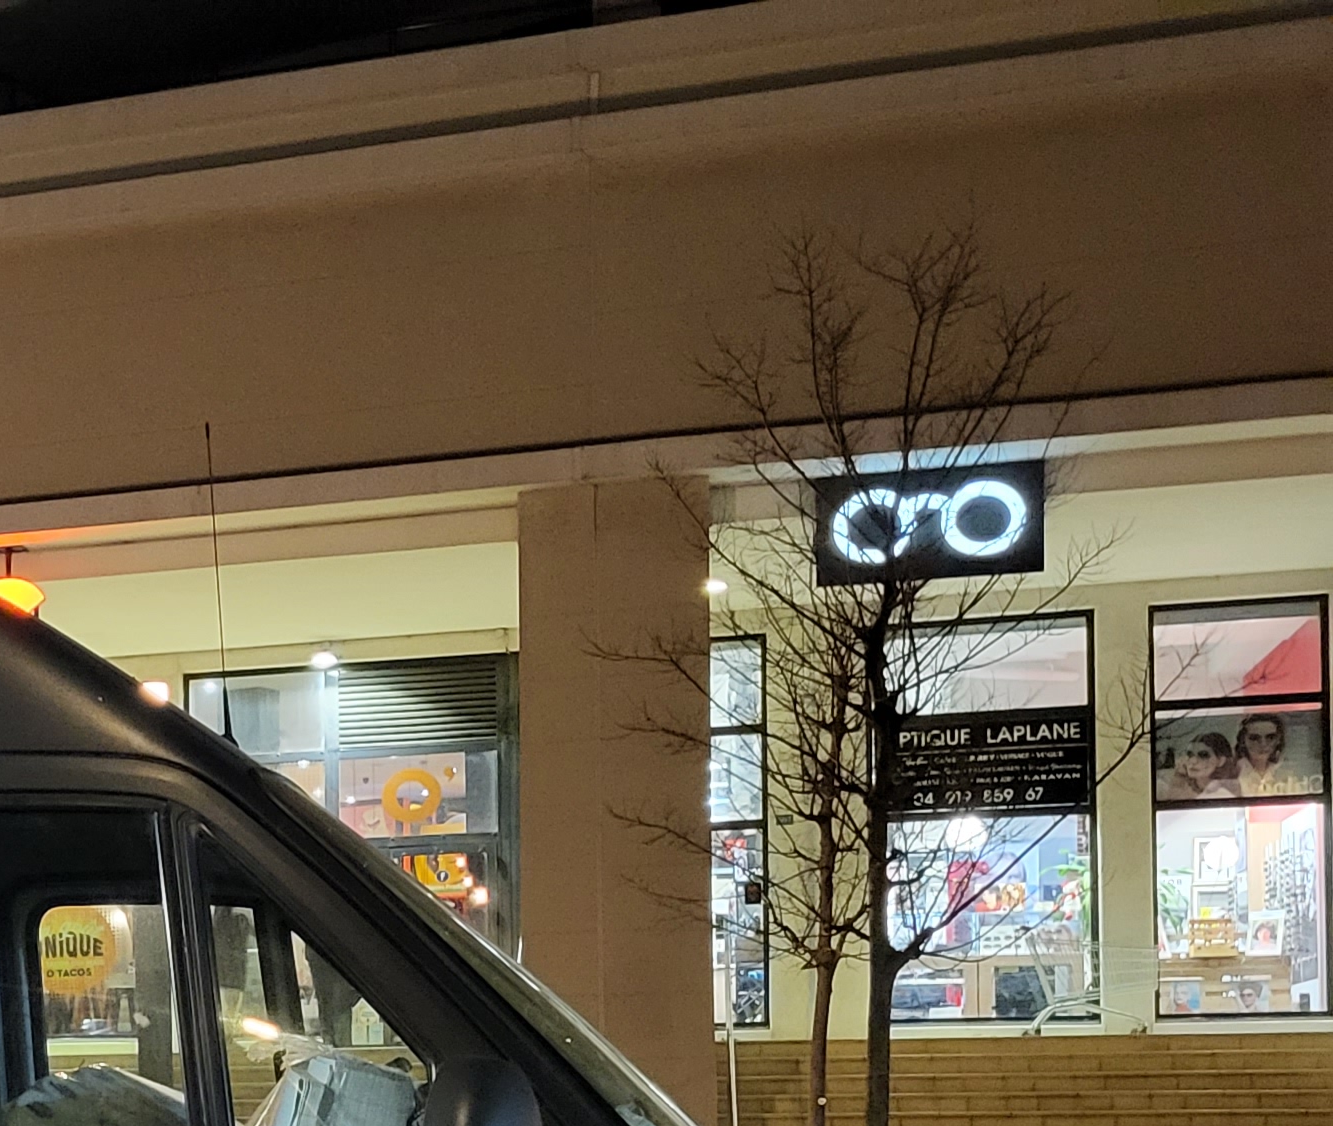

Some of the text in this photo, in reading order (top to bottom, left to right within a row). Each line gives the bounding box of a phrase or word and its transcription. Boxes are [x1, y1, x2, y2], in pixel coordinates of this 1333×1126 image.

[986, 722, 1081, 744] LAPLANE
[1025, 786, 1045, 802] 67
[58, 967, 92, 978] TACOS
